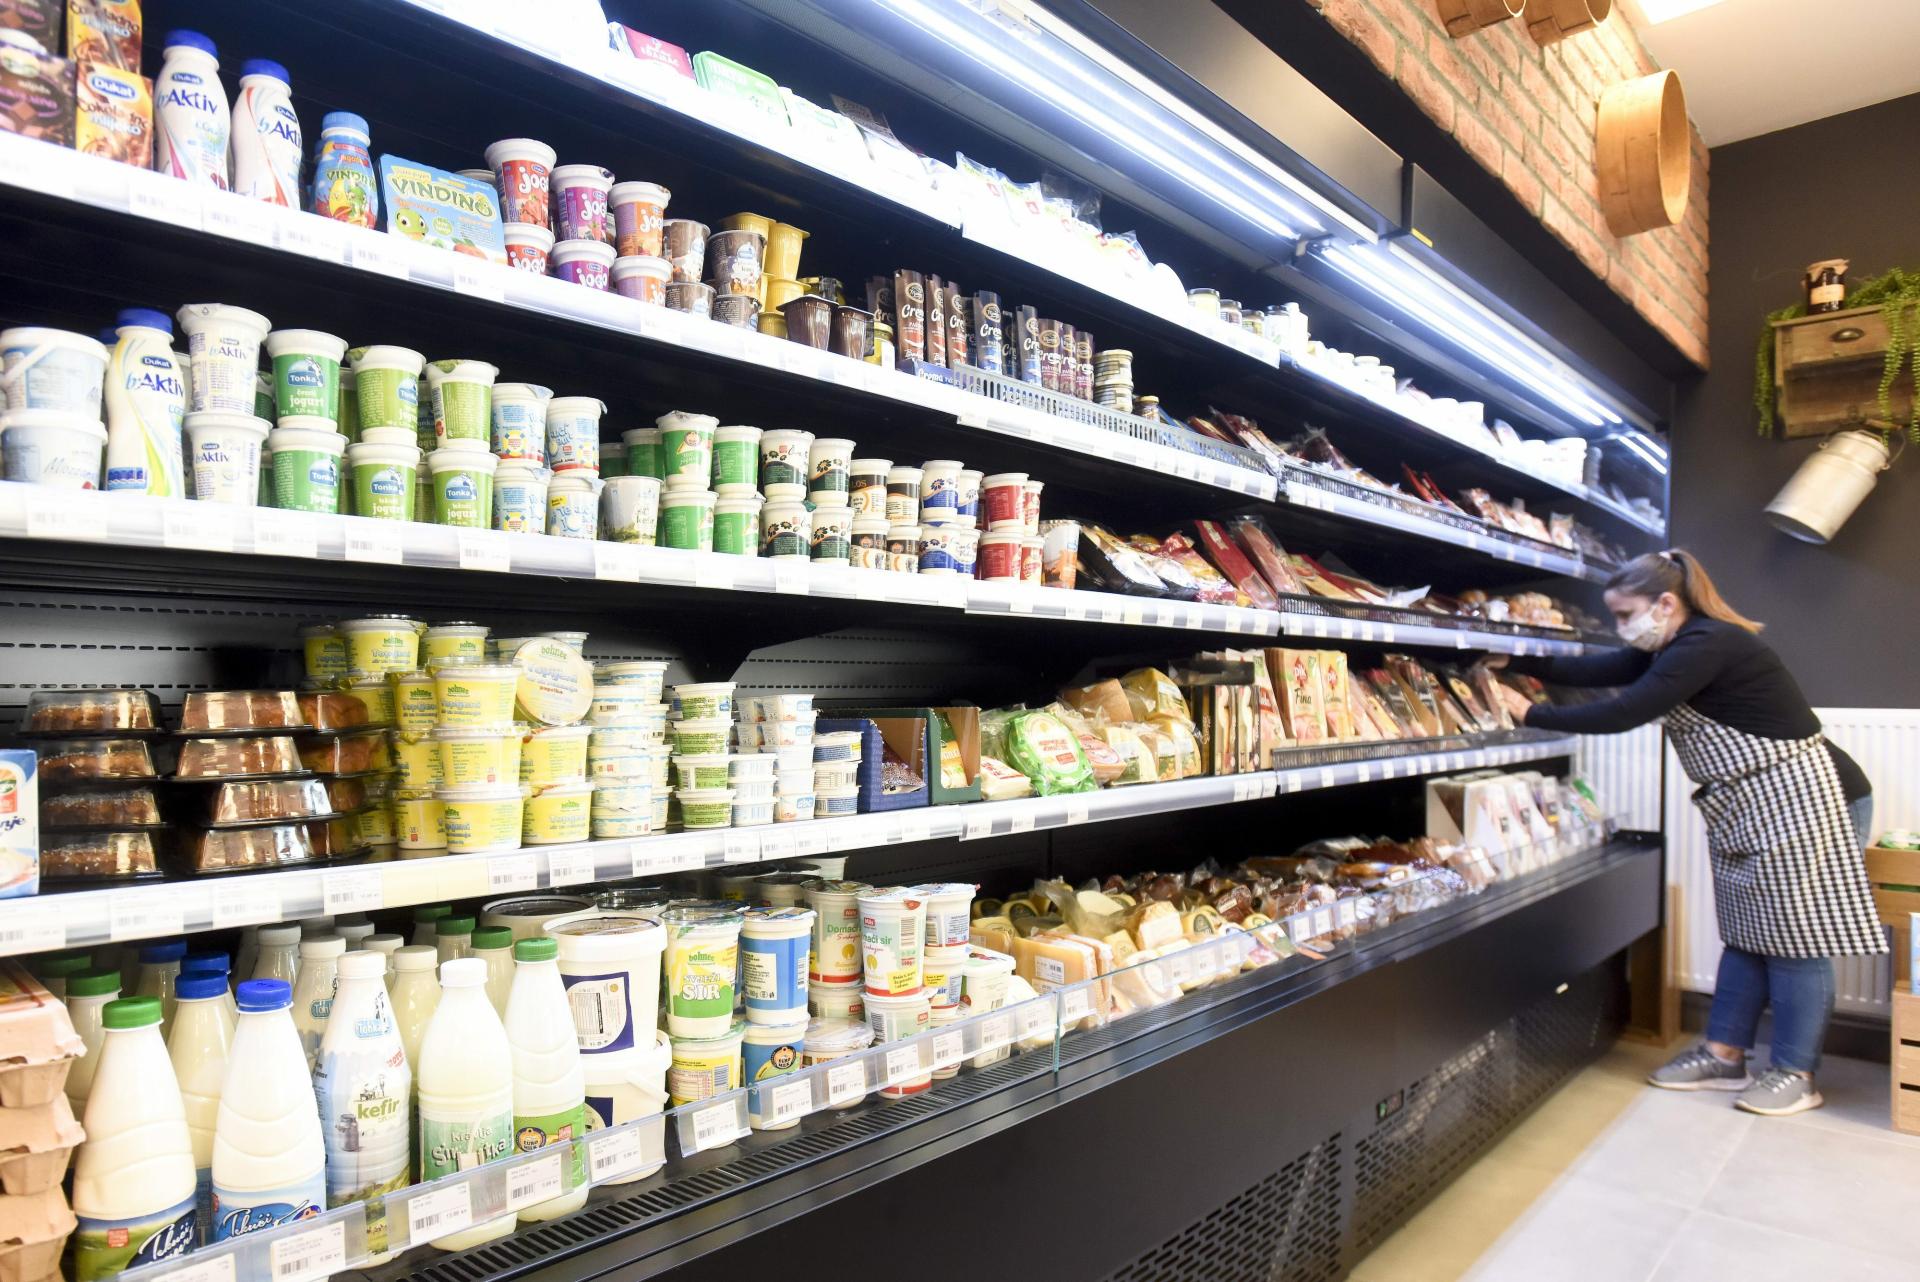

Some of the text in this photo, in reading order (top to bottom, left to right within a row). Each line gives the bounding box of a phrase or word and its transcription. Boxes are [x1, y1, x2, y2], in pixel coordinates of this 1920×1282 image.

[94, 78, 134, 97] Dukat
[391, 176, 493, 218] VINDINO
[143, 356, 172, 369] Dukat
[290, 374, 317, 384] Tonka
[290, 397, 325, 410] jogurt
[373, 483, 398, 492] Tonka
[447, 490, 472, 498] Tonka
[1294, 688, 1312, 704] Fina
[880, 936, 892, 945] sir
[682, 984, 721, 1001] SIR
[357, 1098, 400, 1120] kefir
